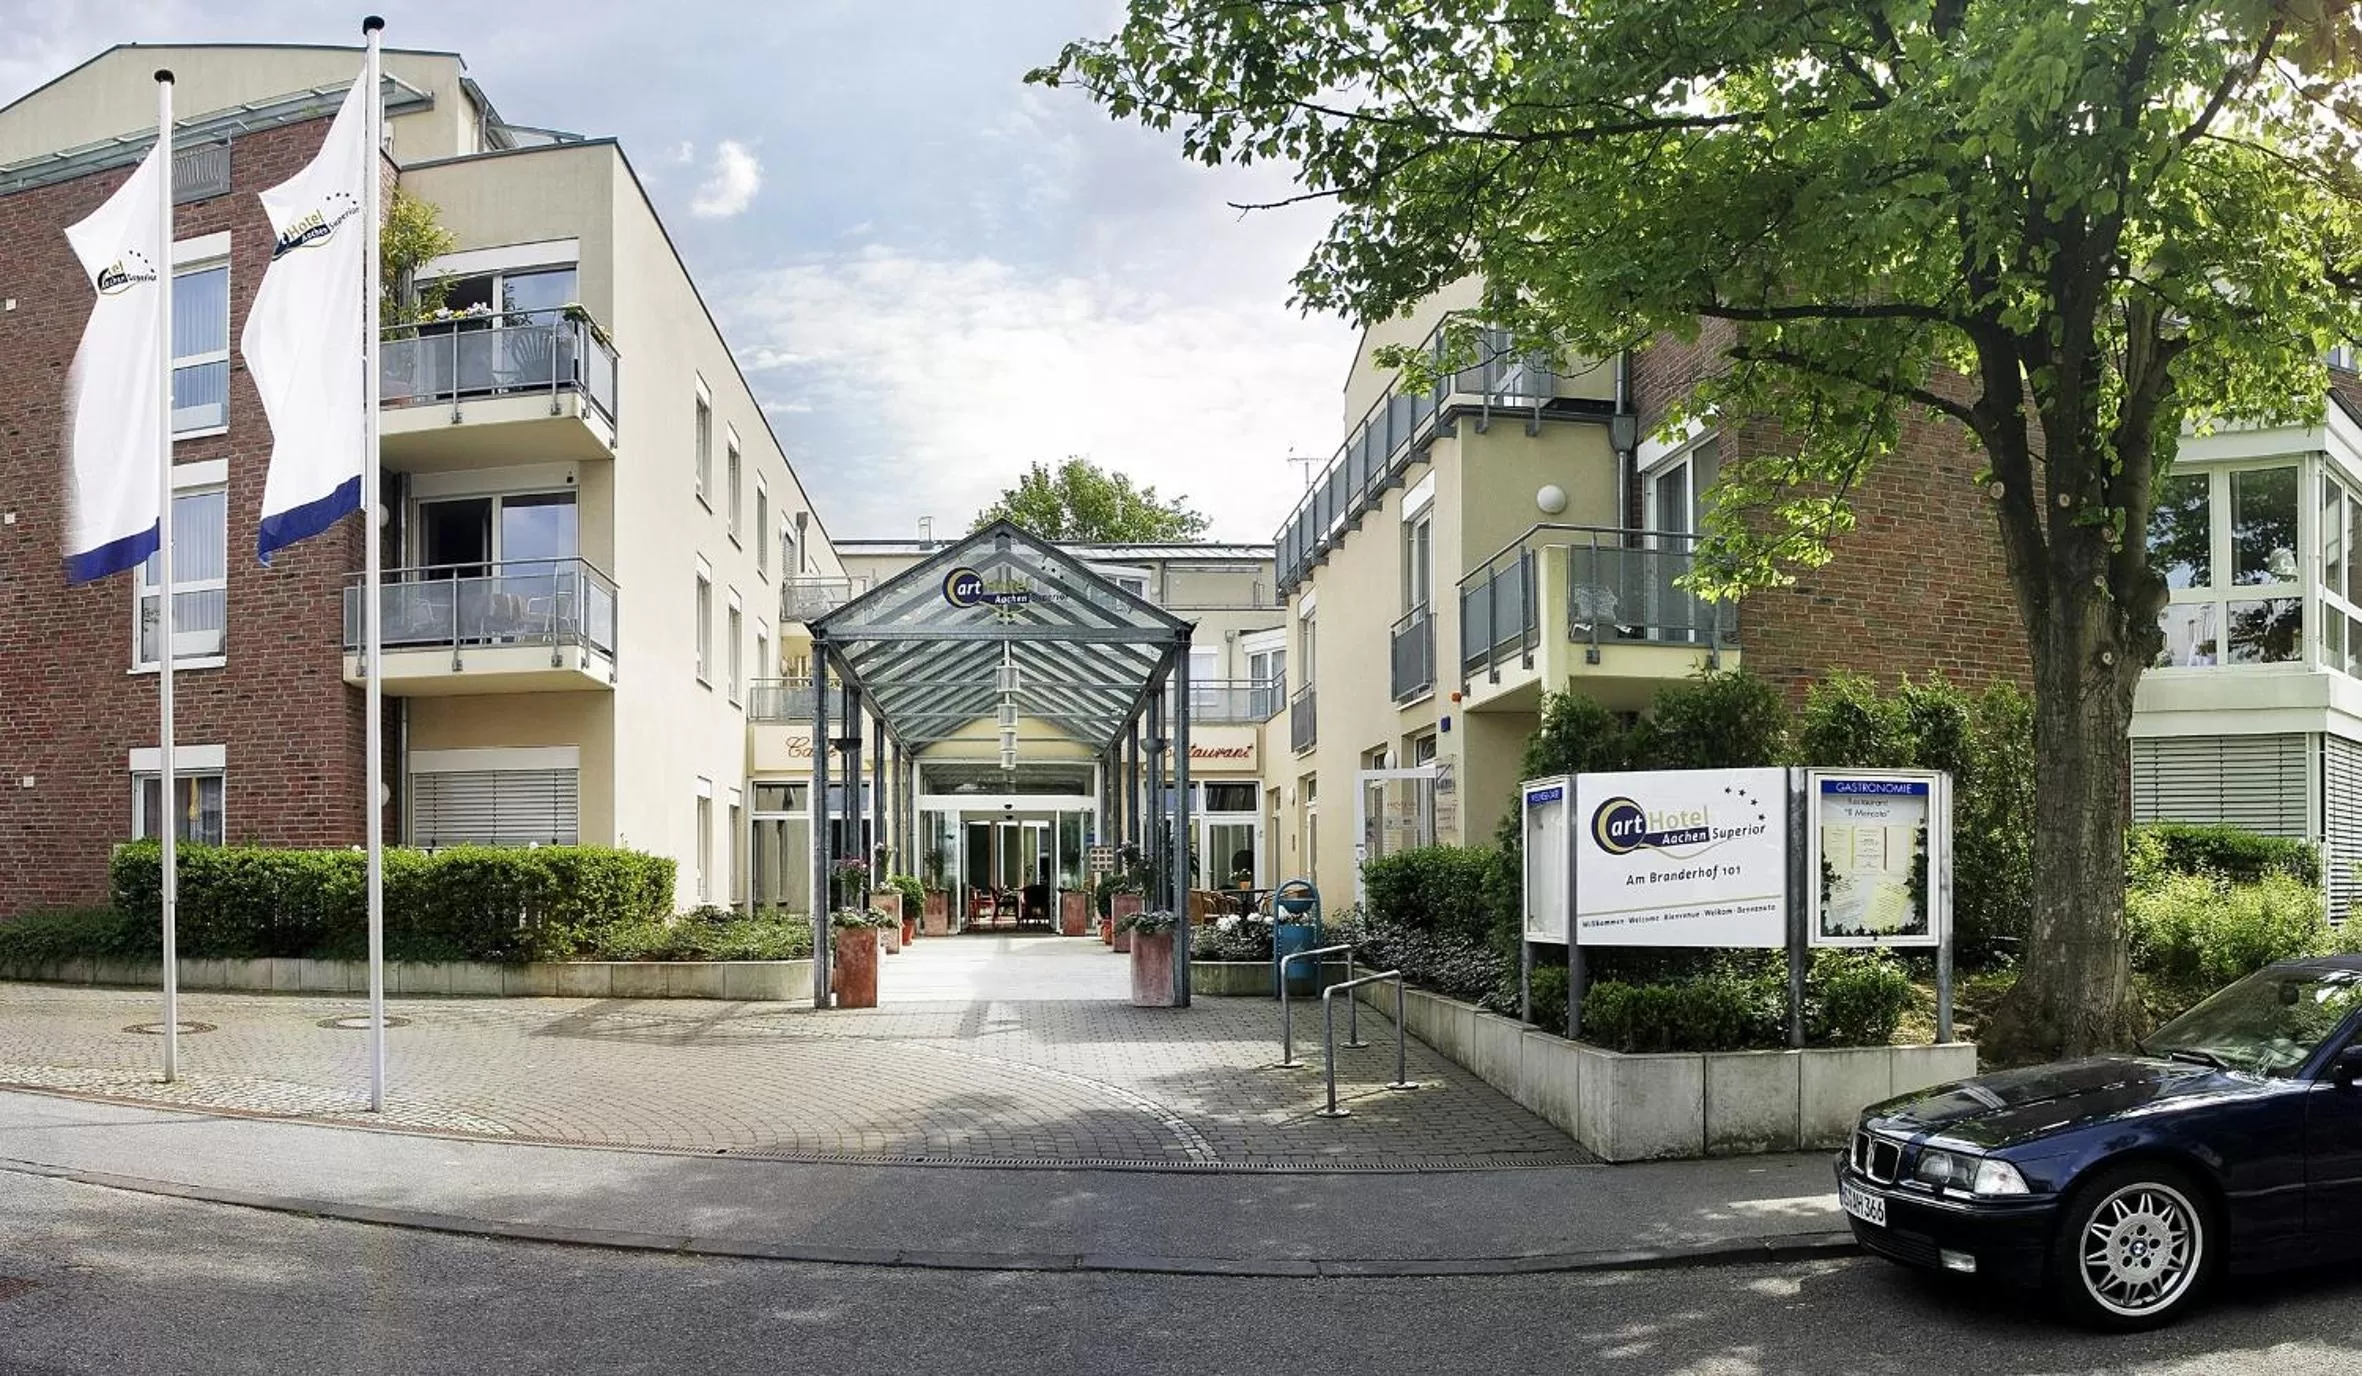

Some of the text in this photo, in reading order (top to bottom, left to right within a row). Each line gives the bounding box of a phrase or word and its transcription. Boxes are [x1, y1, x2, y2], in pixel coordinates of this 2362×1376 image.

[286, 208, 325, 239] Hotel
[957, 580, 982, 596] art
[994, 594, 1028, 604] Aachen
[1835, 782, 1913, 794] GASTRONOMIE
[1611, 806, 1709, 837] art Hotel
[1662, 823, 1767, 845] Aachen Superior
[1626, 864, 1741, 885] Am Branderhof 101
[1864, 1196, 1884, 1222] 366
